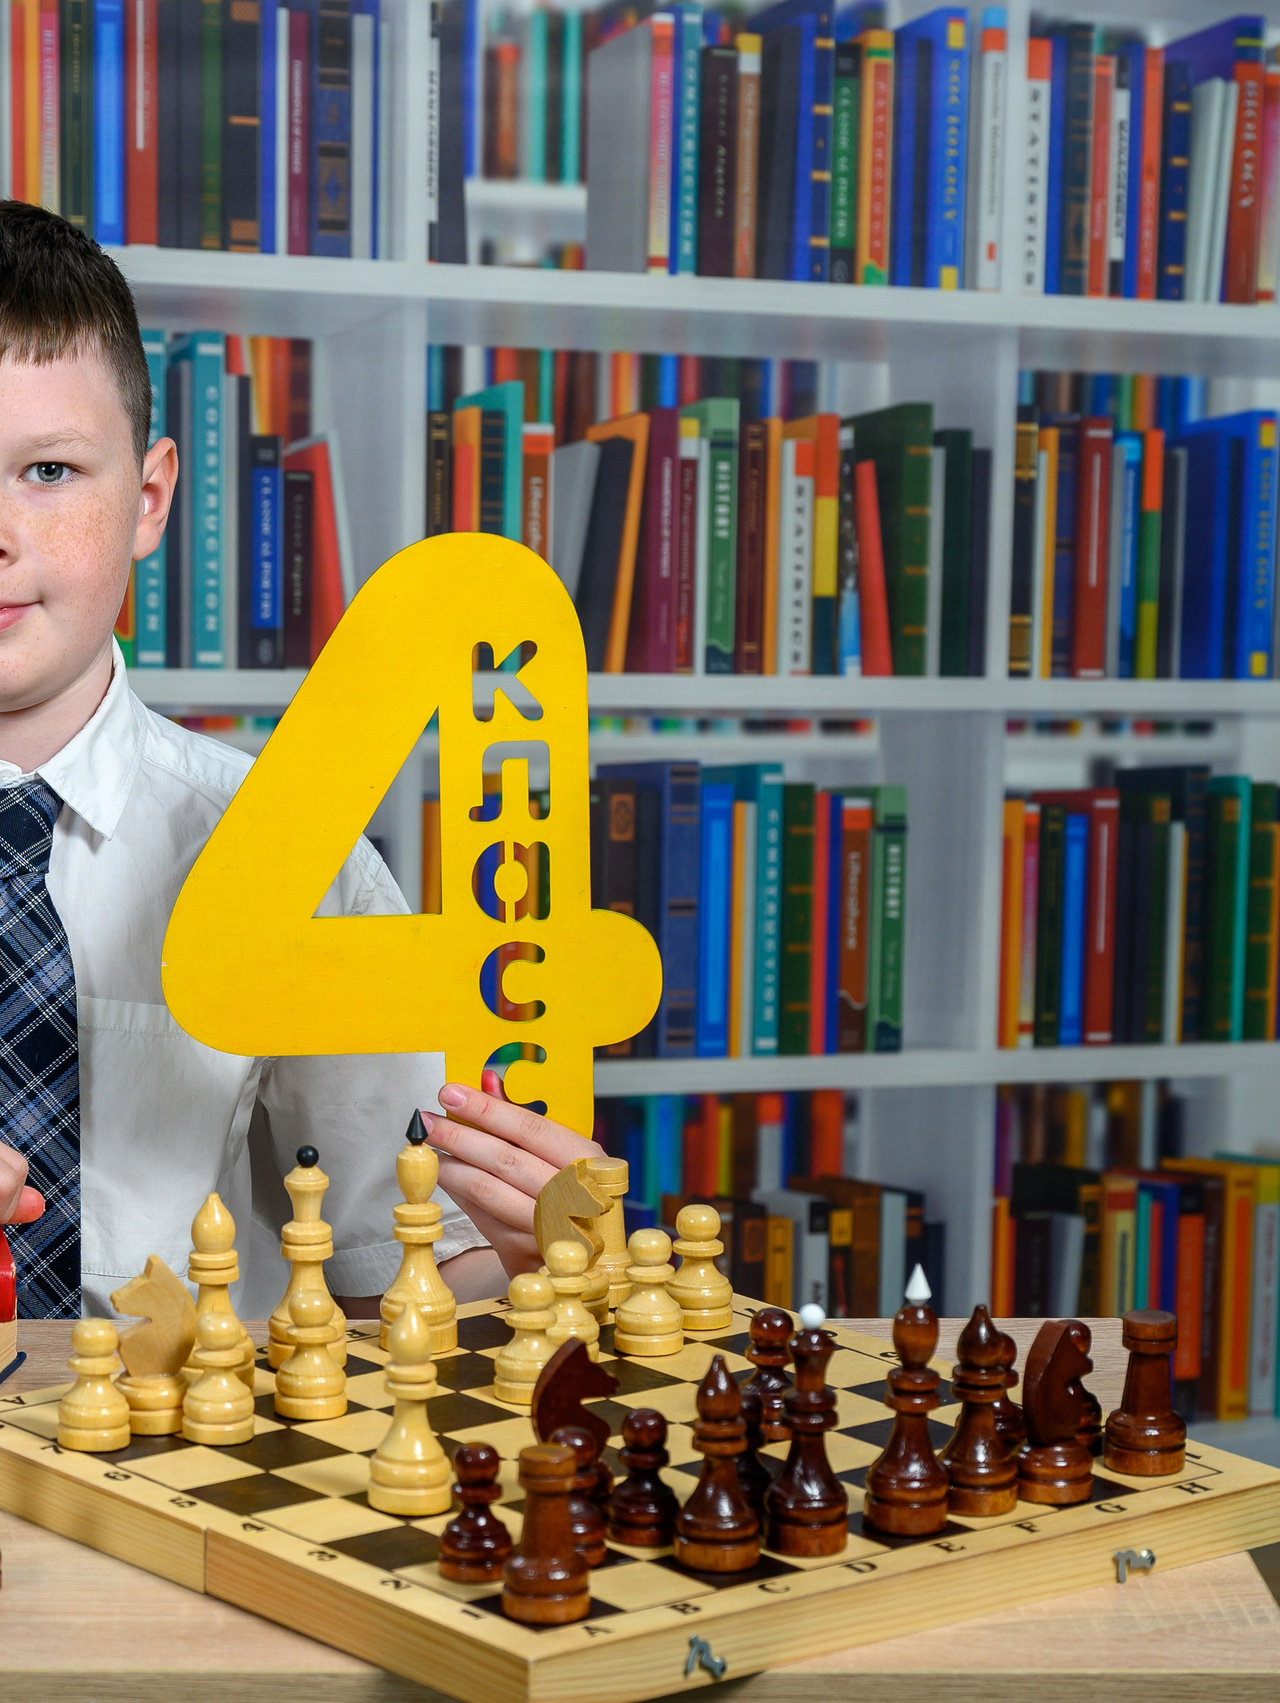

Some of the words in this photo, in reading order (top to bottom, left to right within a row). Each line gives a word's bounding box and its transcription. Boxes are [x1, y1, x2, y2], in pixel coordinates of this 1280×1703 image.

[716, 461, 730, 539] HISTORY
[205, 386, 219, 632] CONSTRUCTION
[40, 1444, 64, 1455] 7
[308, 1550, 338, 1562] 3
[582, 1625, 613, 1637] A
[667, 1603, 703, 1616] B
[758, 1581, 792, 1595] C
[841, 1561, 878, 1574] D
[930, 1541, 966, 1553] E
[1012, 1521, 1042, 1534] F
[1094, 1502, 1128, 1514] G
[1173, 1482, 1214, 1495] H
[380, 1579, 411, 1590] 2
[460, 1608, 488, 1621] 1
